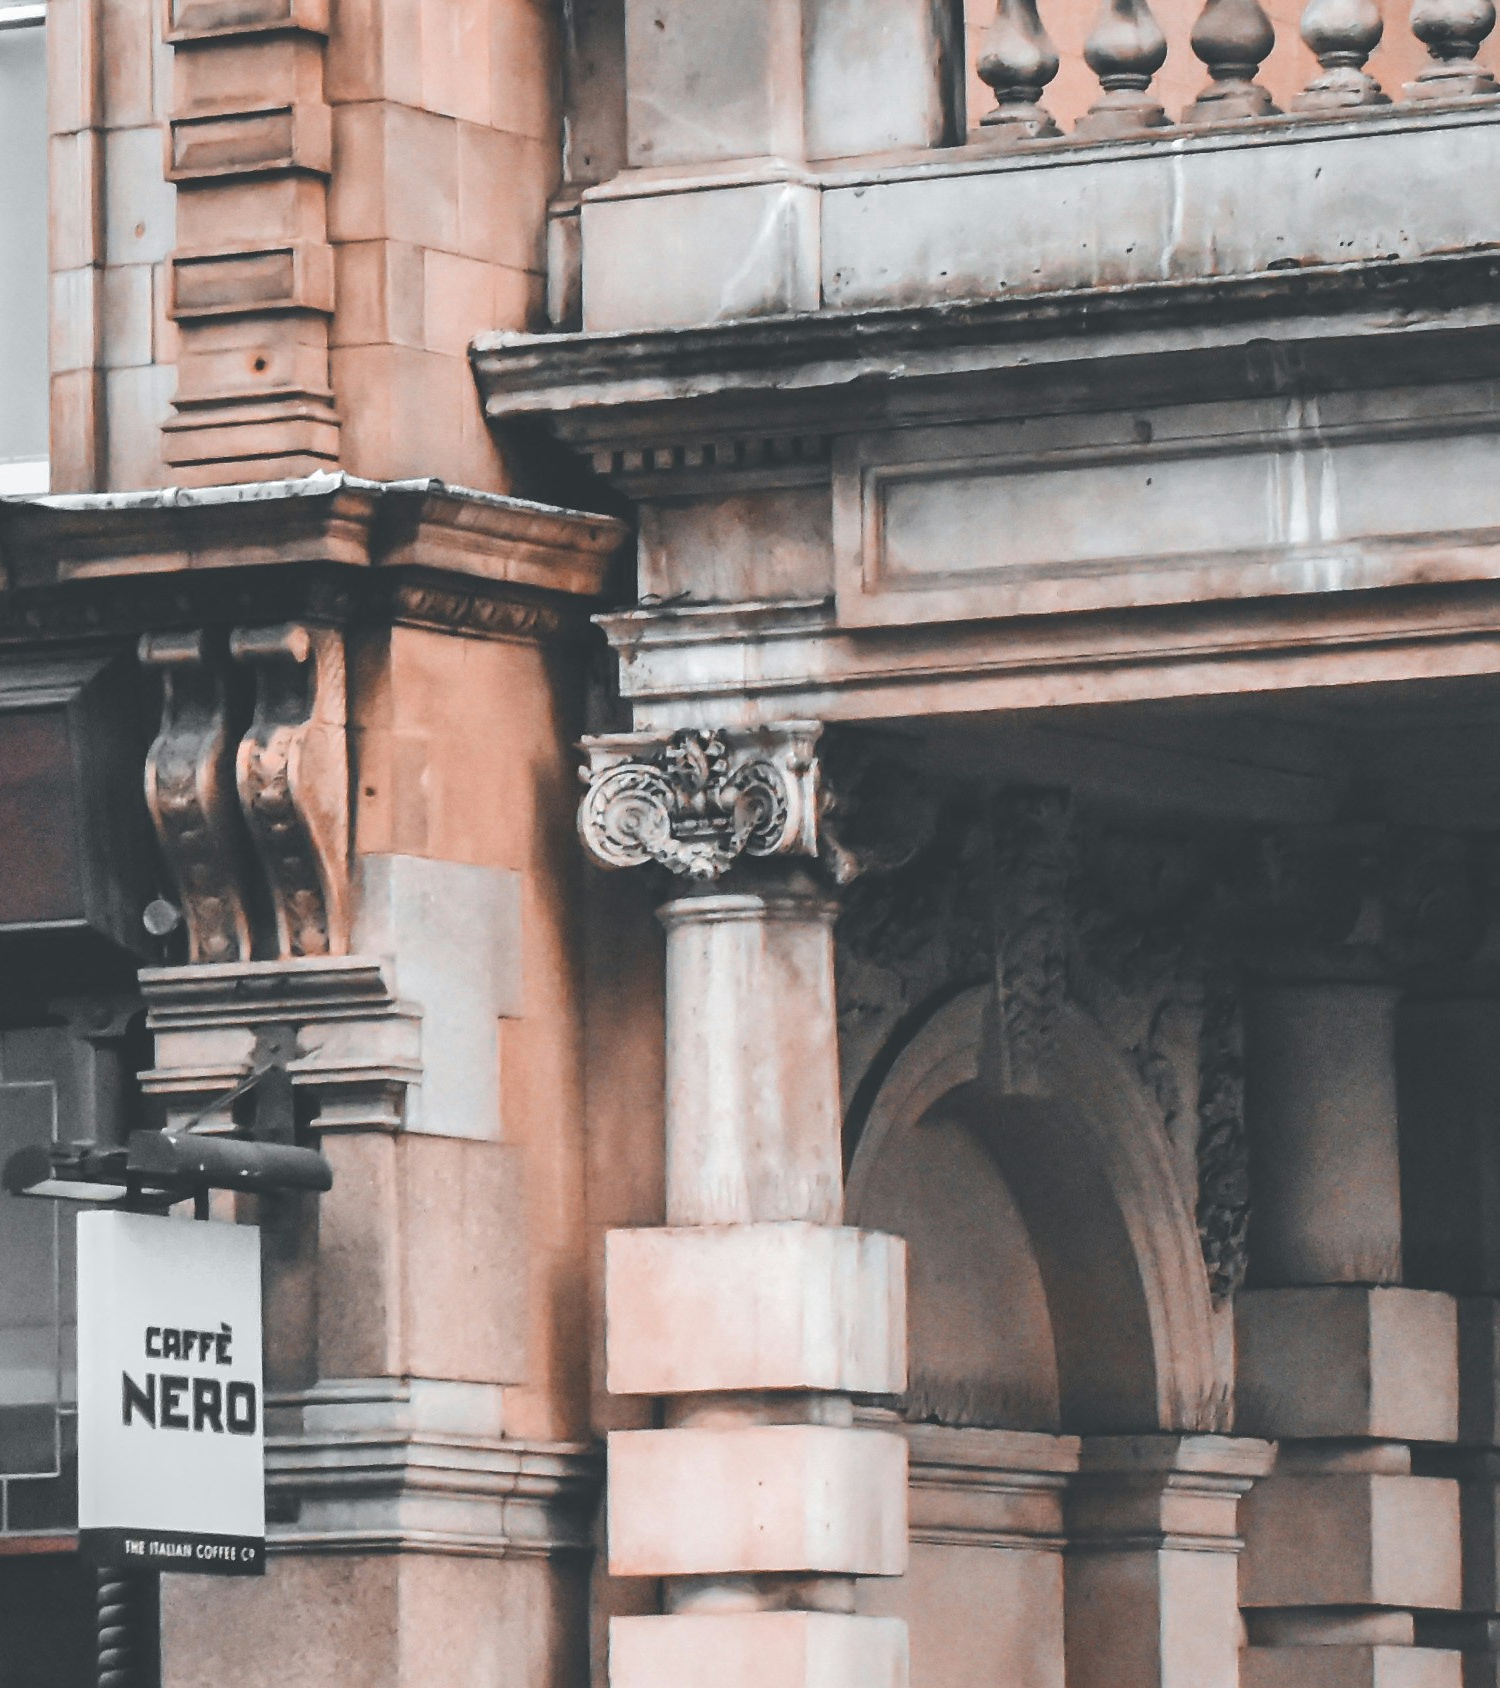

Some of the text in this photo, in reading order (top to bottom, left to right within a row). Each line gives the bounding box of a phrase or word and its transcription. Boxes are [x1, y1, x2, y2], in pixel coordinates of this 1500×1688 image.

[145, 1322, 233, 1365] CAFFÈ
[121, 1371, 257, 1436] NERO
[125, 1540, 145, 1555] THE
[149, 1541, 192, 1557] ITALIAN
[196, 1544, 236, 1561] COFFEE
